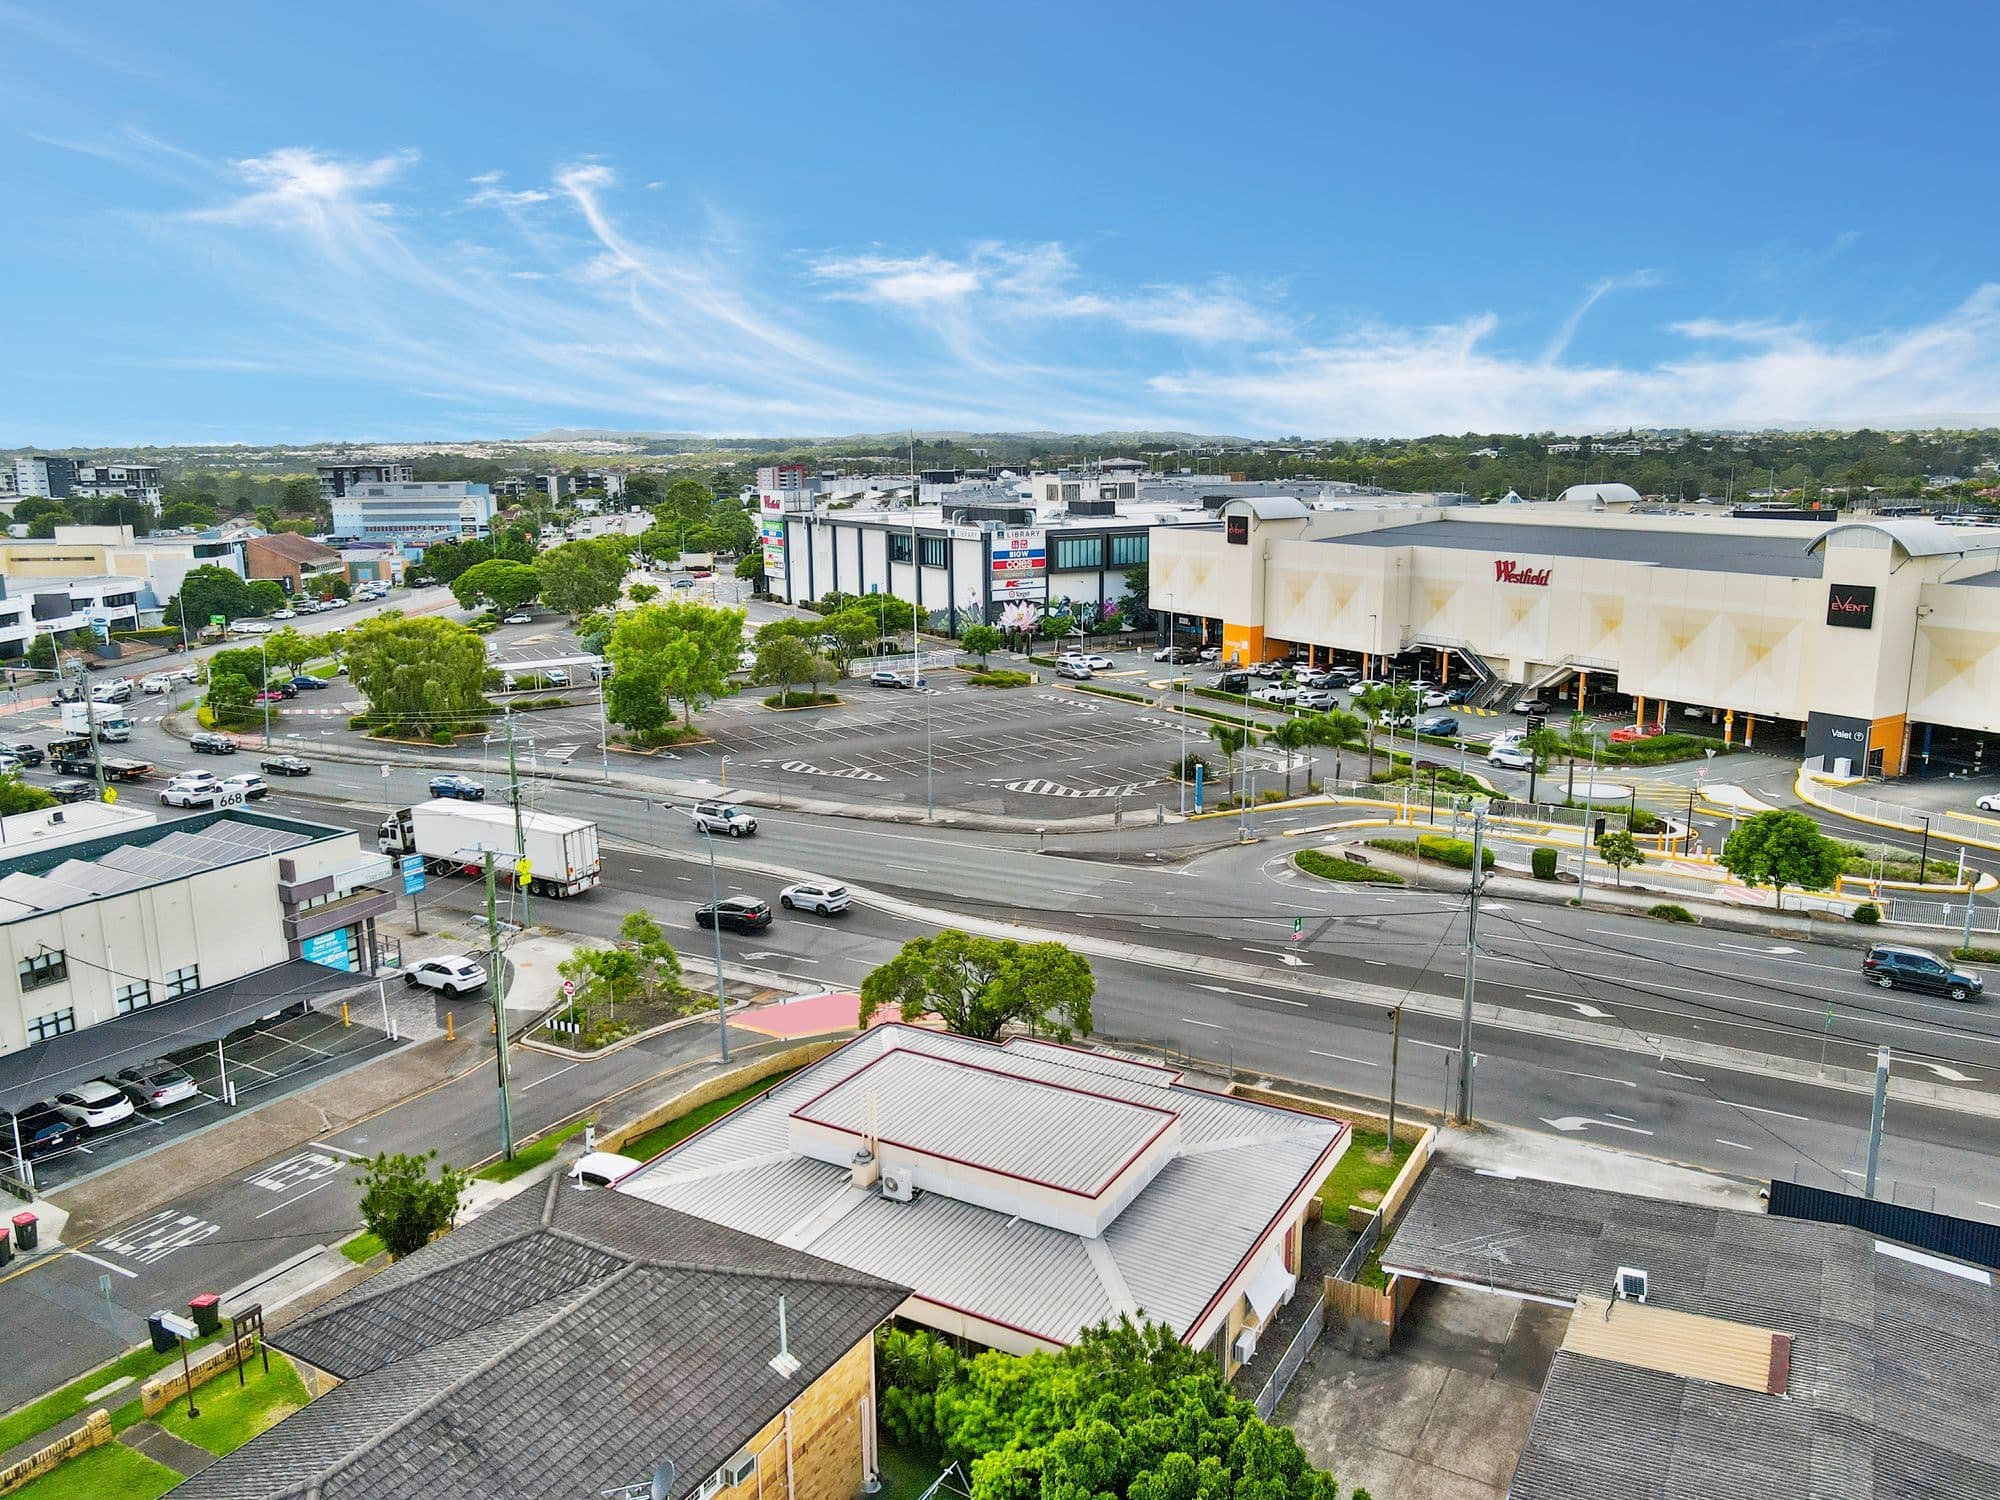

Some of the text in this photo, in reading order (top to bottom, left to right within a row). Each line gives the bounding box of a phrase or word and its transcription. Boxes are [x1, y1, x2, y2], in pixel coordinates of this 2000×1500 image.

[1006, 530, 1040, 538] LIBRARY
[1006, 559, 1032, 569] coles
[1494, 560, 1552, 586] Westfield
[1831, 595, 1870, 613] EVENT
[1831, 728, 1852, 740] Valet
[220, 792, 242, 807] 668
[96, 1209, 222, 1265] CLEAR
